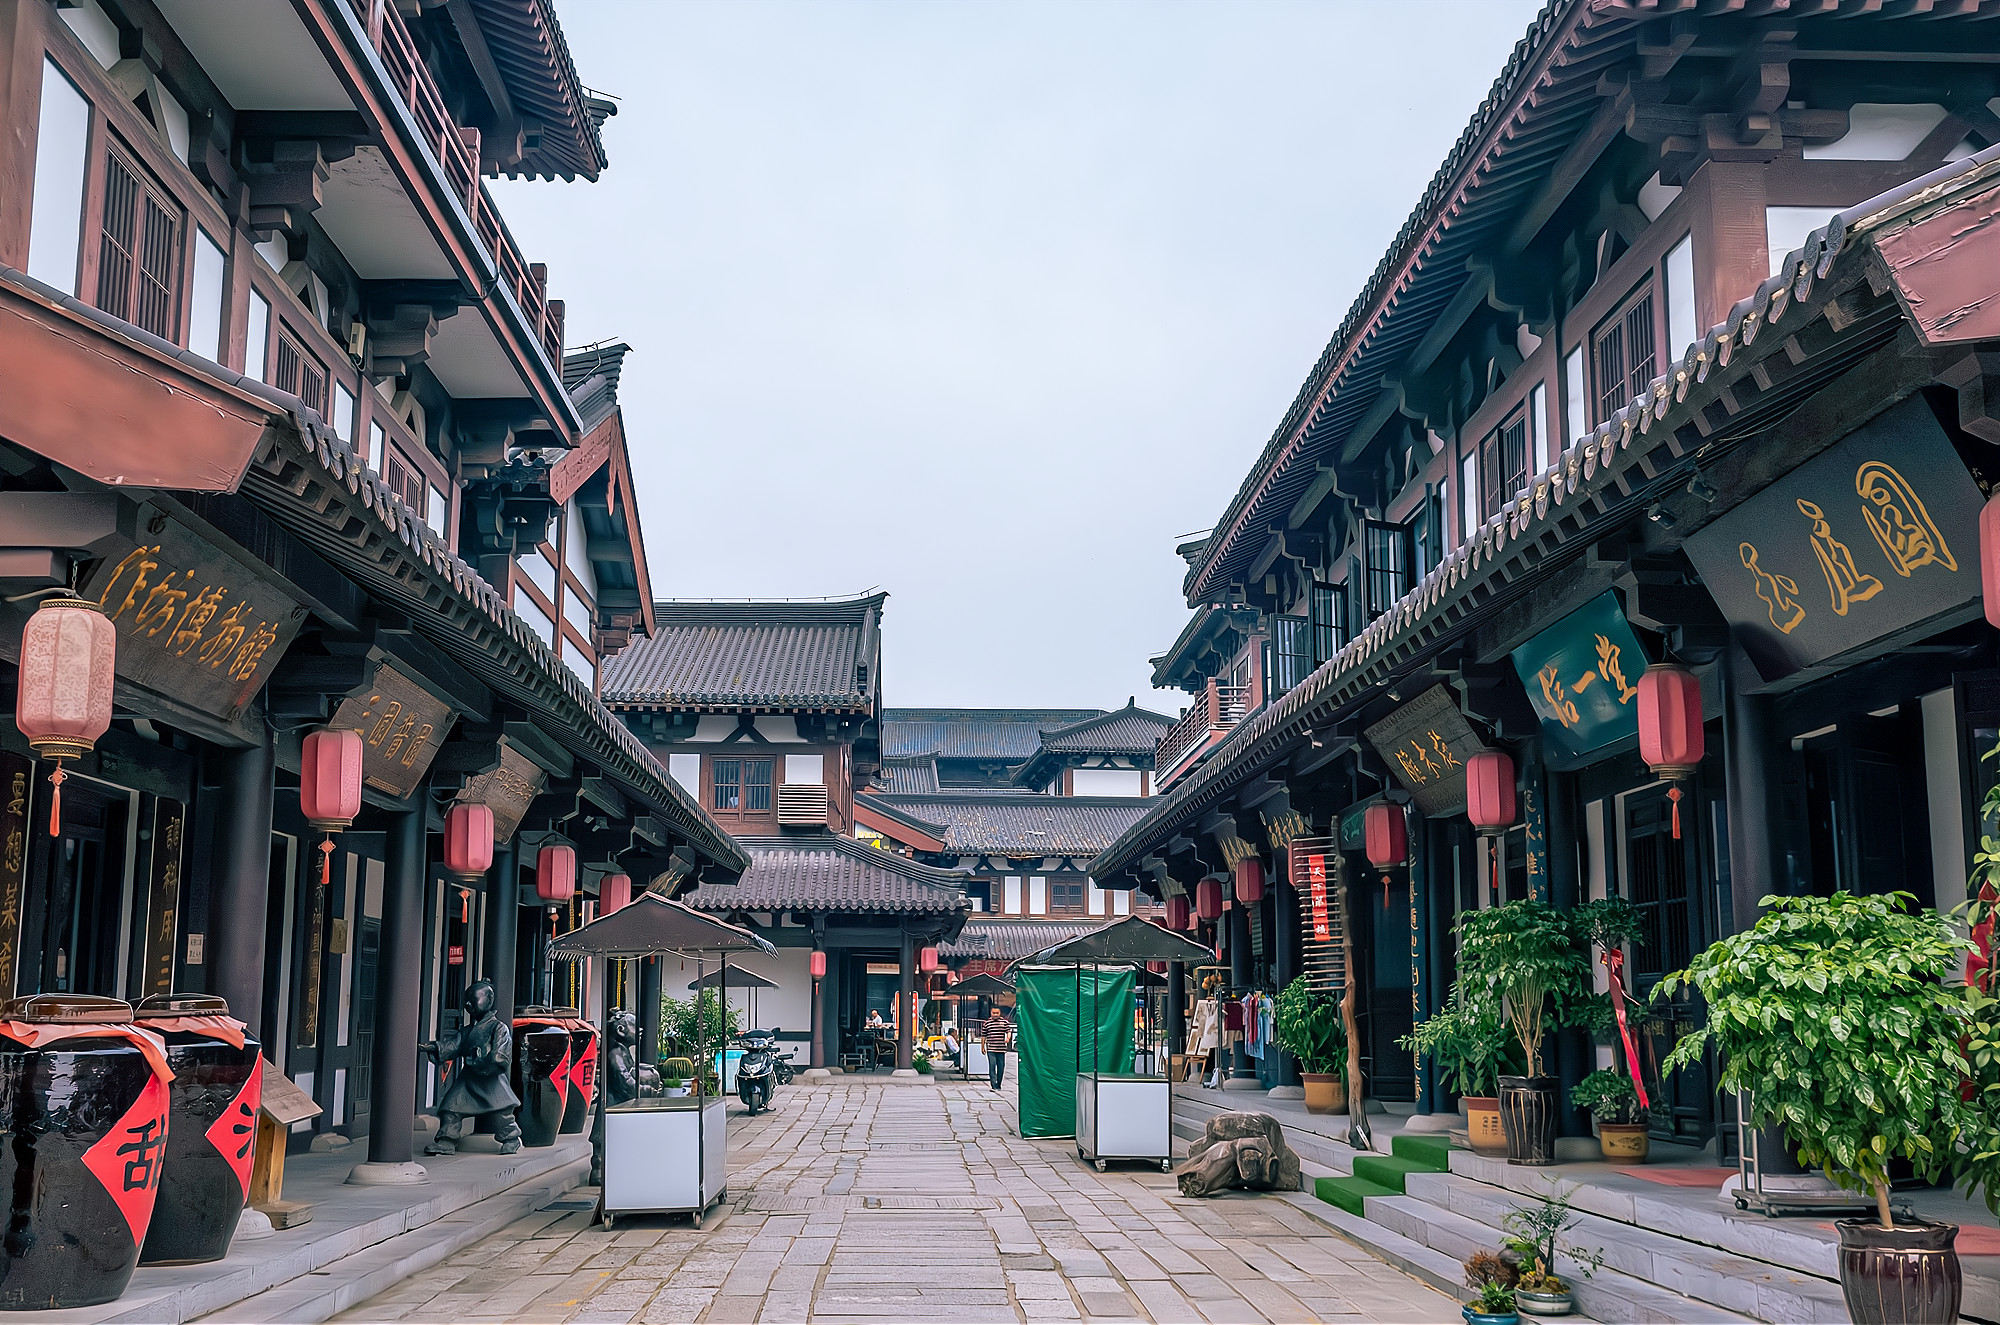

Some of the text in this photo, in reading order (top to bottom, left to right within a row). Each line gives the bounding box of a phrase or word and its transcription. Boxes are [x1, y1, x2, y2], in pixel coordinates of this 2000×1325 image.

[101, 545, 279, 682] 作坊博物館
